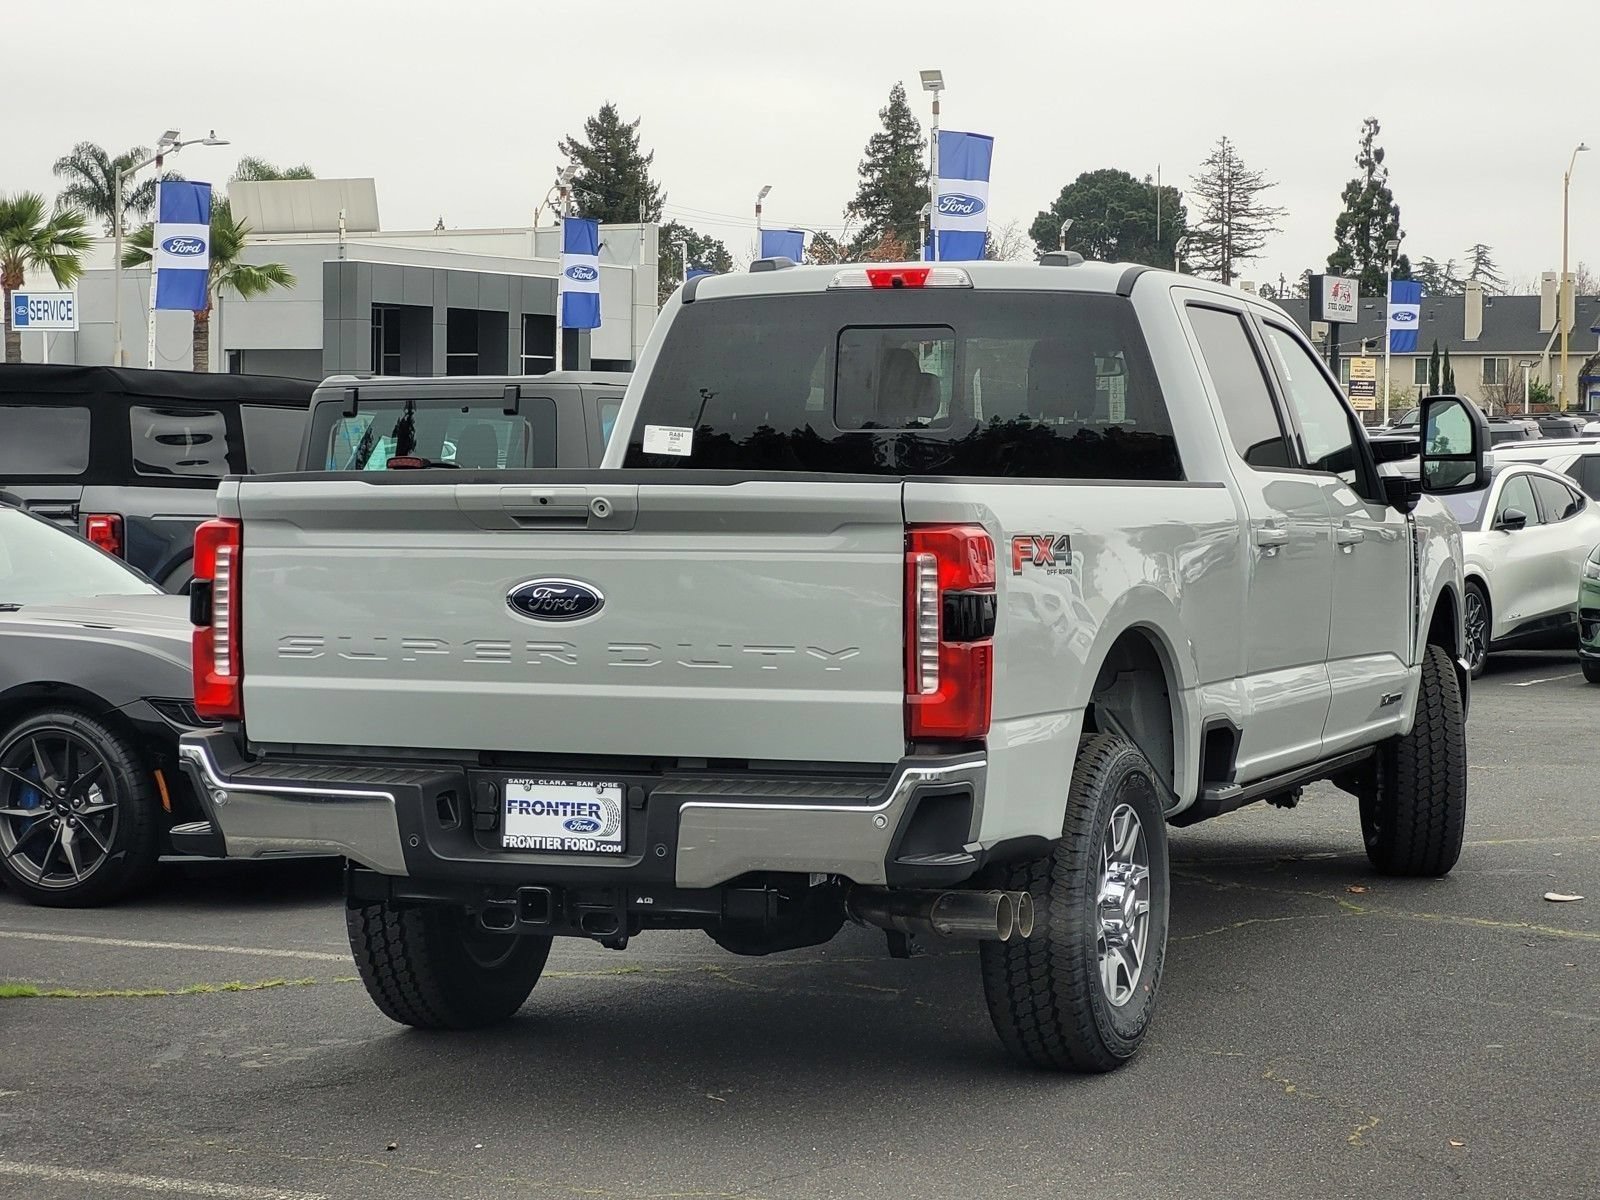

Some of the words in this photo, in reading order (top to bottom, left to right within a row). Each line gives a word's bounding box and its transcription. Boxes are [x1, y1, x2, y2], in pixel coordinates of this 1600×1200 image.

[939, 196, 975, 213] Ford
[169, 239, 202, 253] Ford
[572, 267, 594, 279] Ford
[29, 300, 73, 321] SERVICE
[1011, 534, 1073, 576] FX4
[527, 586, 581, 612] Ford
[278, 635, 578, 666] SUPER
[607, 642, 861, 672] DUTY
[507, 778, 535, 786] SANTA
[538, 779, 568, 787] CLARA
[576, 780, 594, 788] SAN
[507, 799, 603, 822] FRONTIER
[569, 820, 595, 832] Ford
[502, 835, 562, 851] FRONTIER
